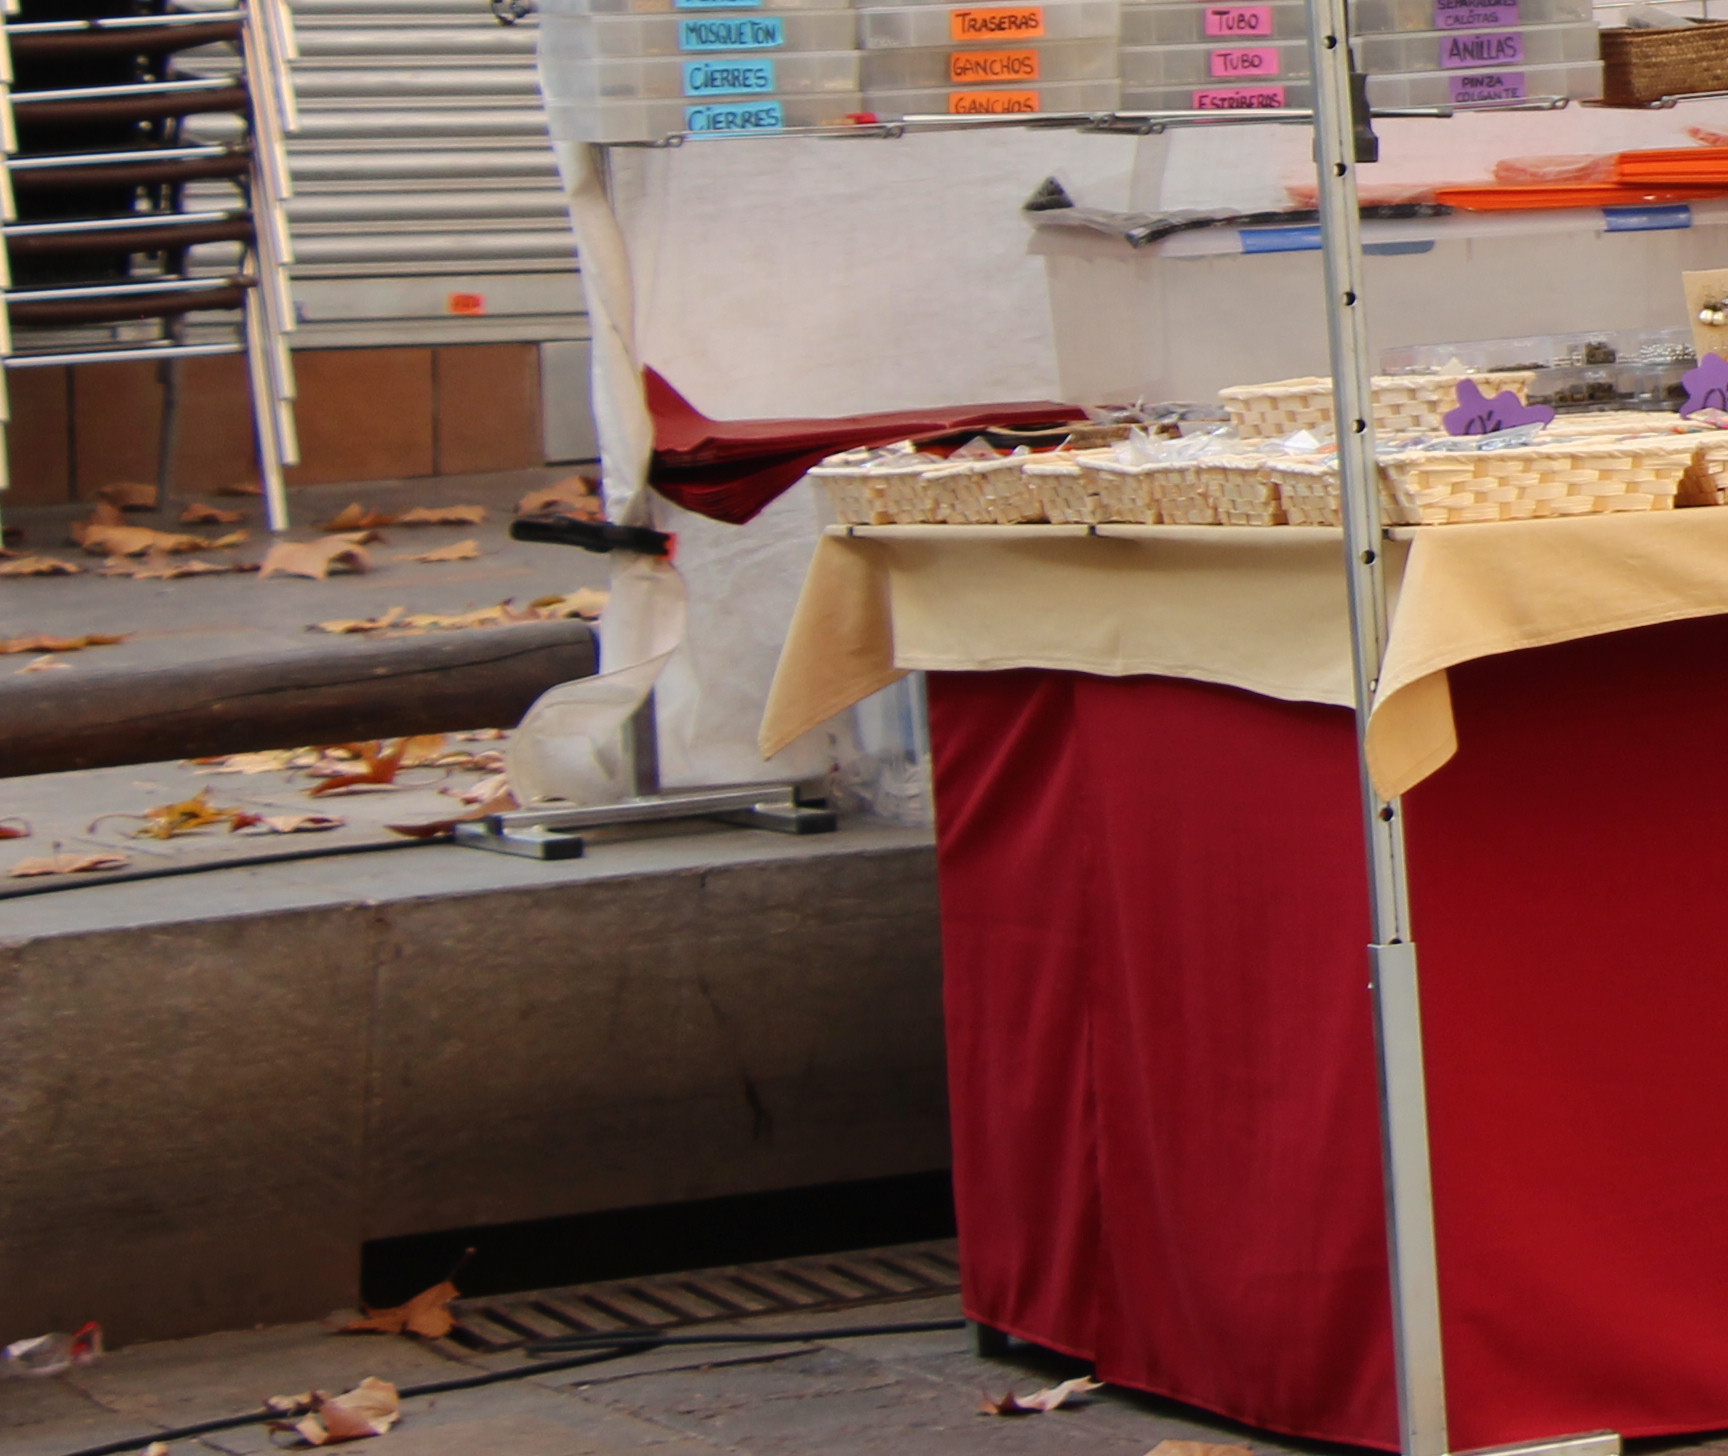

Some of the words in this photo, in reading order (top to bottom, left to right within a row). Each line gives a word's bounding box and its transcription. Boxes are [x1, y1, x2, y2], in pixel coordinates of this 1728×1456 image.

[955, 12, 1039, 33] TRASERAS
[1211, 11, 1259, 31] TUBO
[685, 20, 776, 45] MOSQUETON
[1450, 36, 1517, 62] ANILLAS
[952, 55, 1034, 76] GANCHOS
[1216, 53, 1262, 71] TUBO
[690, 63, 768, 90] CIERRES
[1461, 76, 1503, 89] PINZA
[954, 97, 1034, 114] GANCHOS
[688, 107, 779, 131] CIERRES
